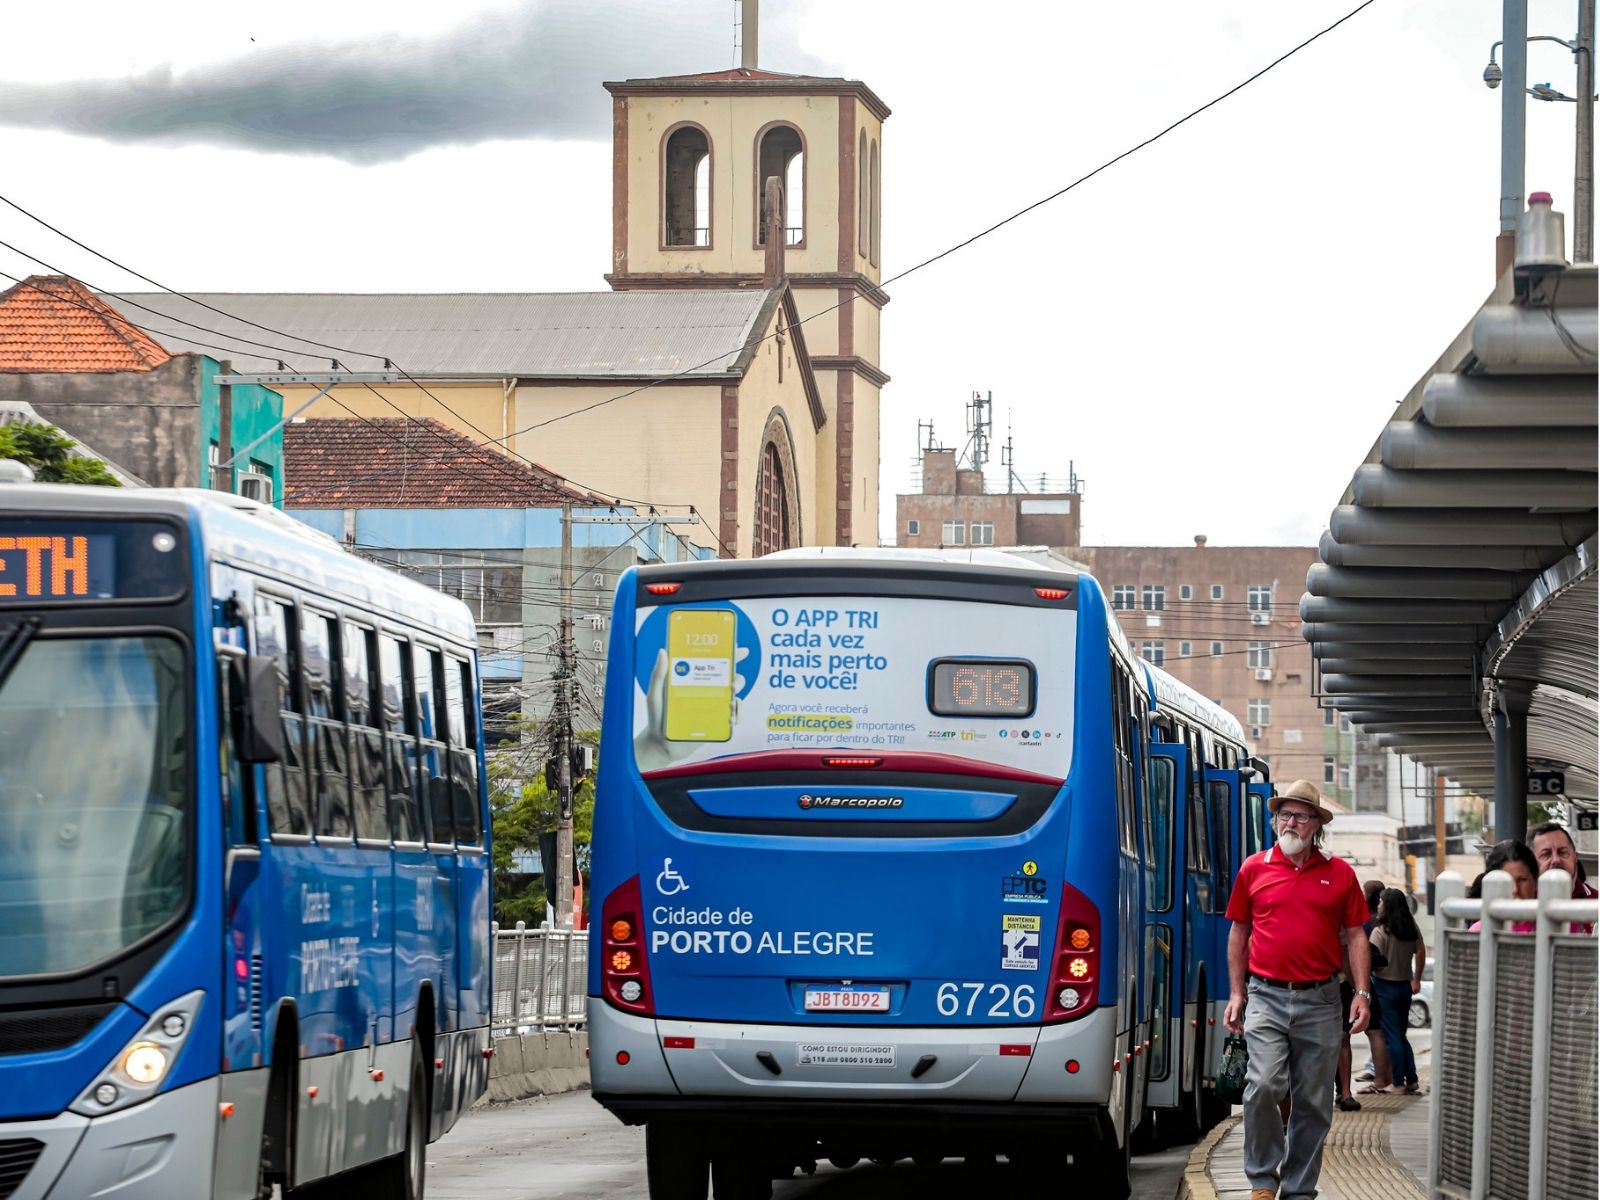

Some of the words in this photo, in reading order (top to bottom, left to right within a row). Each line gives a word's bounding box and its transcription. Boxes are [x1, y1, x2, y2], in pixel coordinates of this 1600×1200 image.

[771, 608, 789, 627] O
[795, 609, 839, 627] APP
[845, 610, 878, 628] TRI
[770, 628, 821, 647] cada
[828, 634, 864, 649] vez
[770, 650, 822, 668] mais
[829, 653, 887, 674] perto
[769, 670, 796, 689] de
[802, 671, 858, 690] você!
[953, 668, 1020, 706] 613
[768, 703, 797, 714] Agora
[800, 703, 822, 713] você
[825, 704, 868, 714] receberá
[768, 716, 853, 732] notificações
[856, 720, 916, 732] importantes
[767, 733, 790, 743] para
[792, 732, 813, 742] ficar
[816, 735, 832, 744] por
[836, 733, 869, 743] dentro
[872, 734, 884, 744] do
[888, 735, 905, 745] TRI!
[1528, 778, 1542, 793] B
[1546, 778, 1561, 793] C
[814, 797, 903, 808] Marcopolo
[1001, 876, 1048, 894] EPTC
[652, 906, 723, 925] Cidade
[728, 907, 753, 925] de
[652, 930, 753, 954] PORTO
[756, 931, 874, 956] ALEGRE
[813, 992, 880, 1007] JBT8D92
[936, 982, 1036, 1018] 6726
